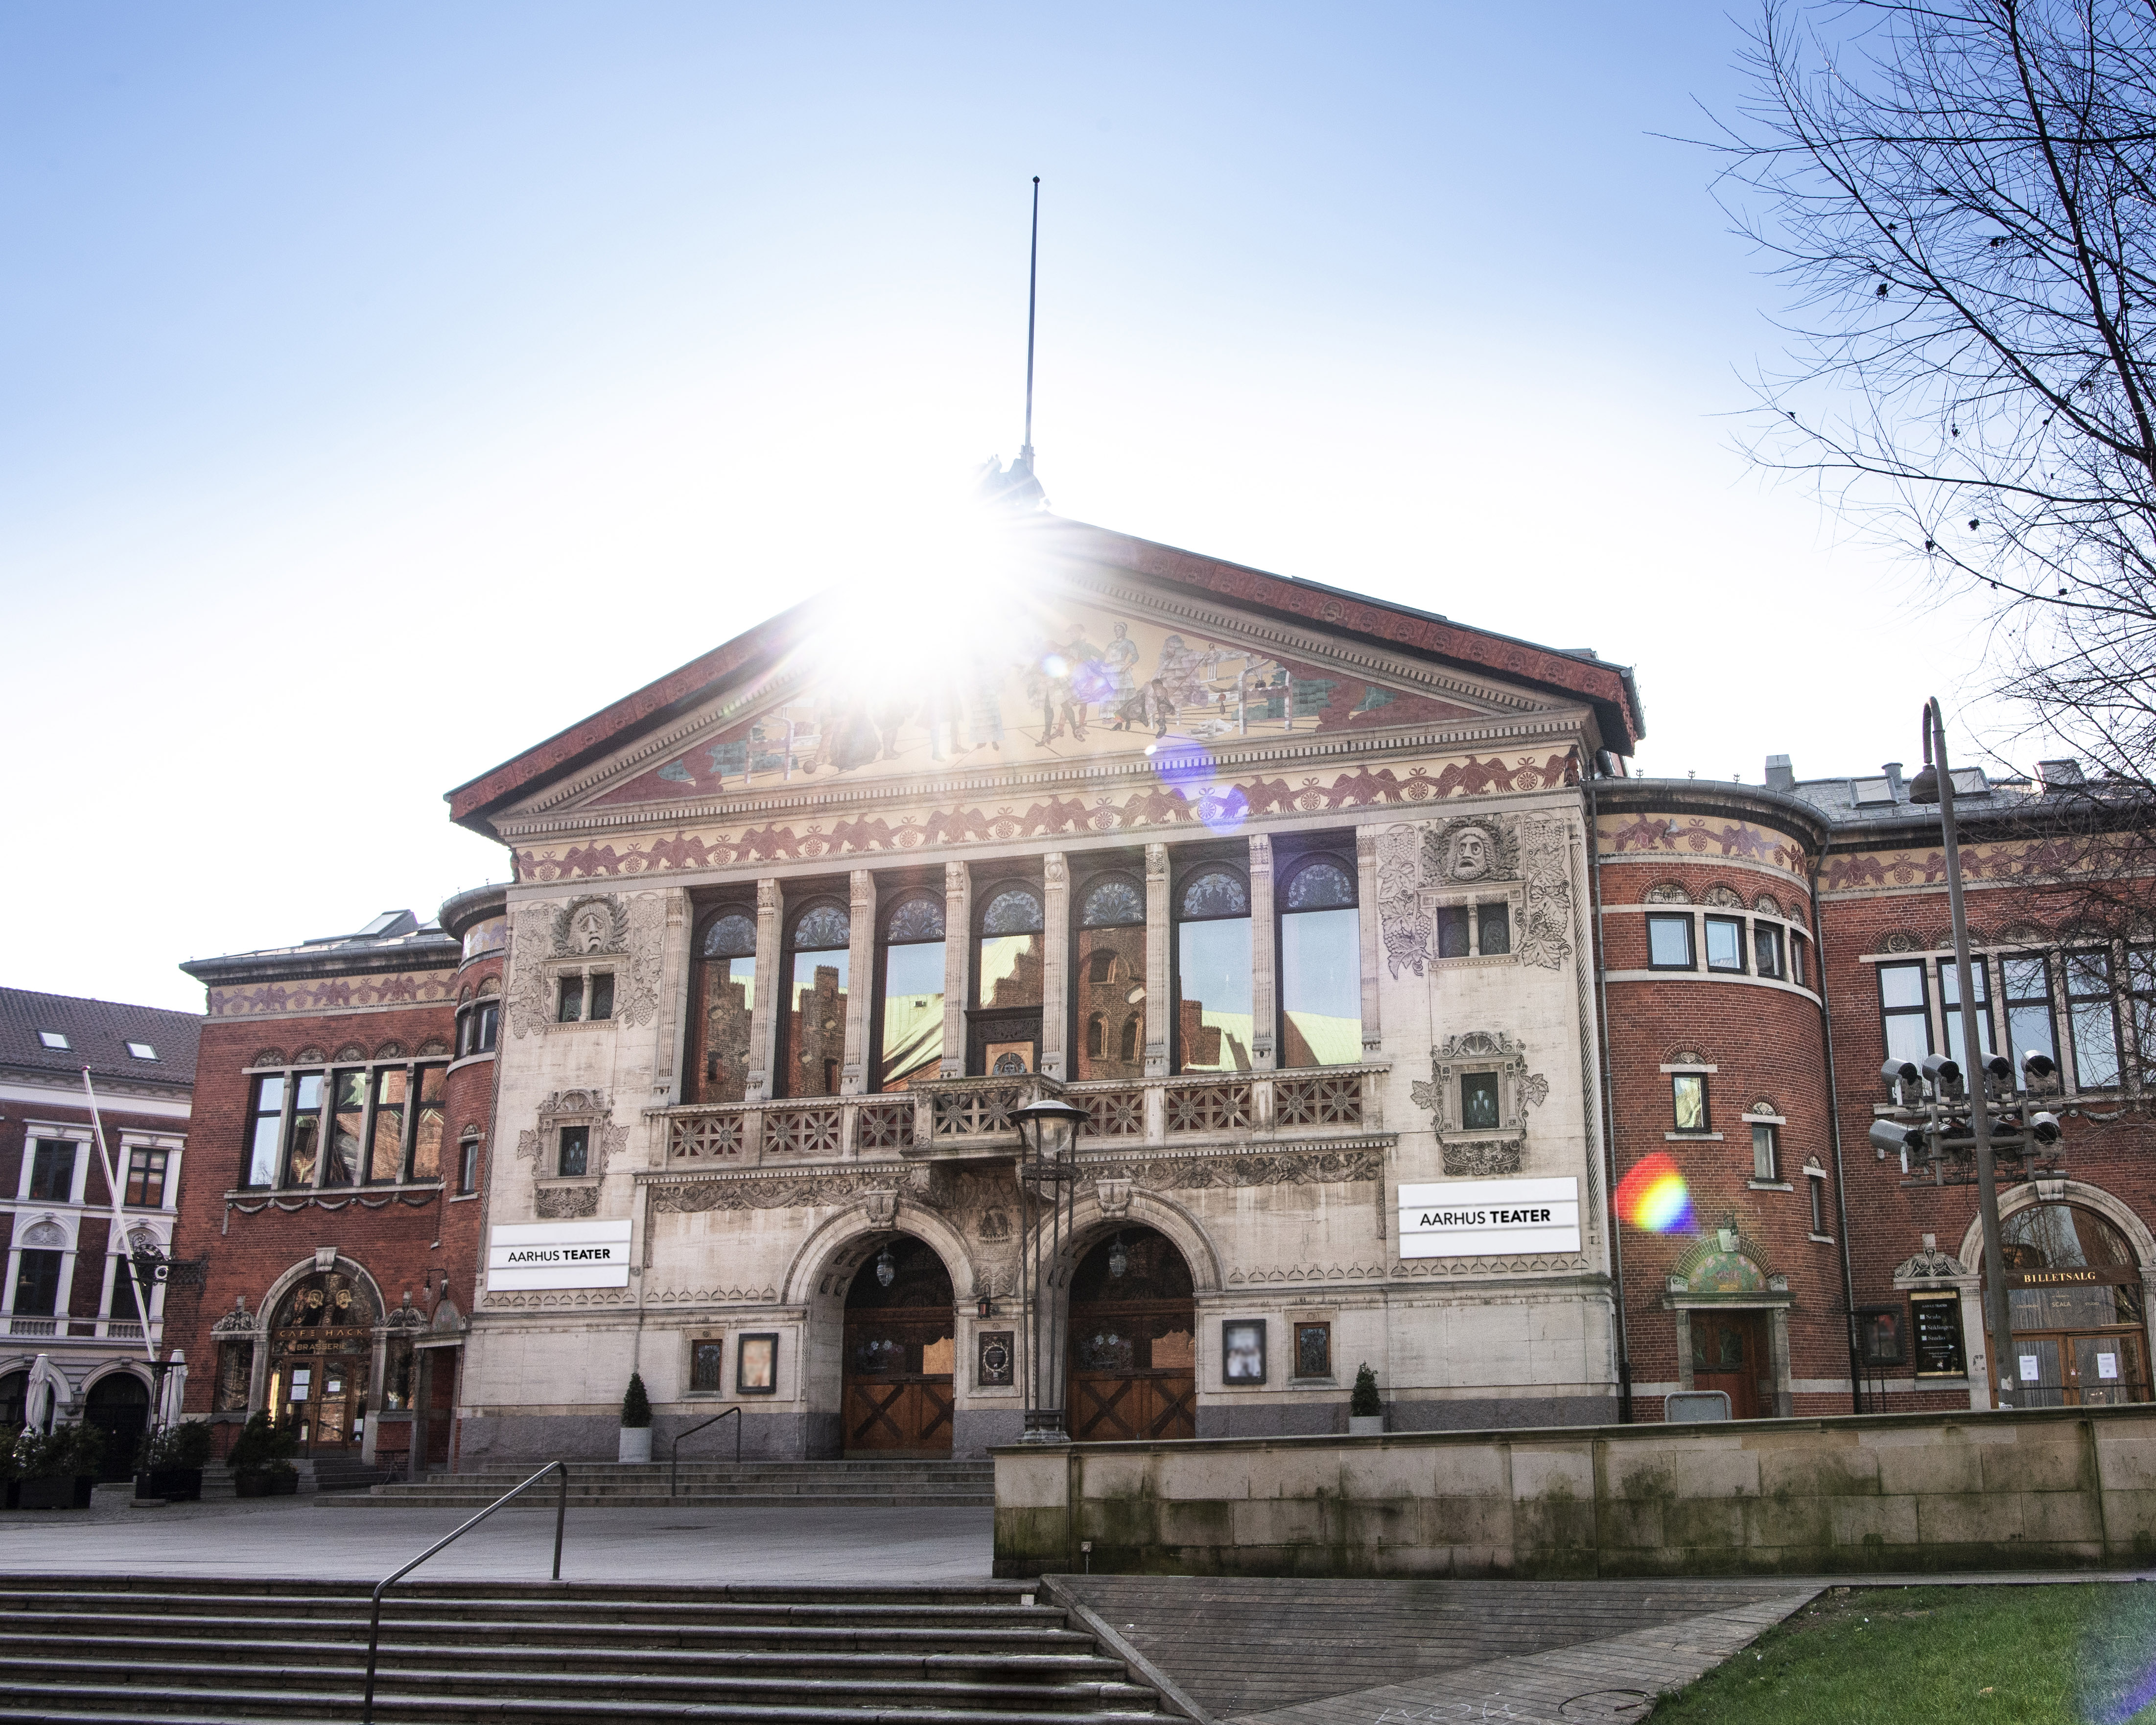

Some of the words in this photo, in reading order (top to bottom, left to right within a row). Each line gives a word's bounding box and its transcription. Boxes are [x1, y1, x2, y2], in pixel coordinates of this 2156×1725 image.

[1420, 1211, 1485, 1226] AARHUS
[1490, 1209, 1550, 1223] TEATER
[508, 1251, 560, 1262] AARHUS
[563, 1249, 610, 1260] TEATER
[2024, 1272, 2095, 1283] BILLETSALG
